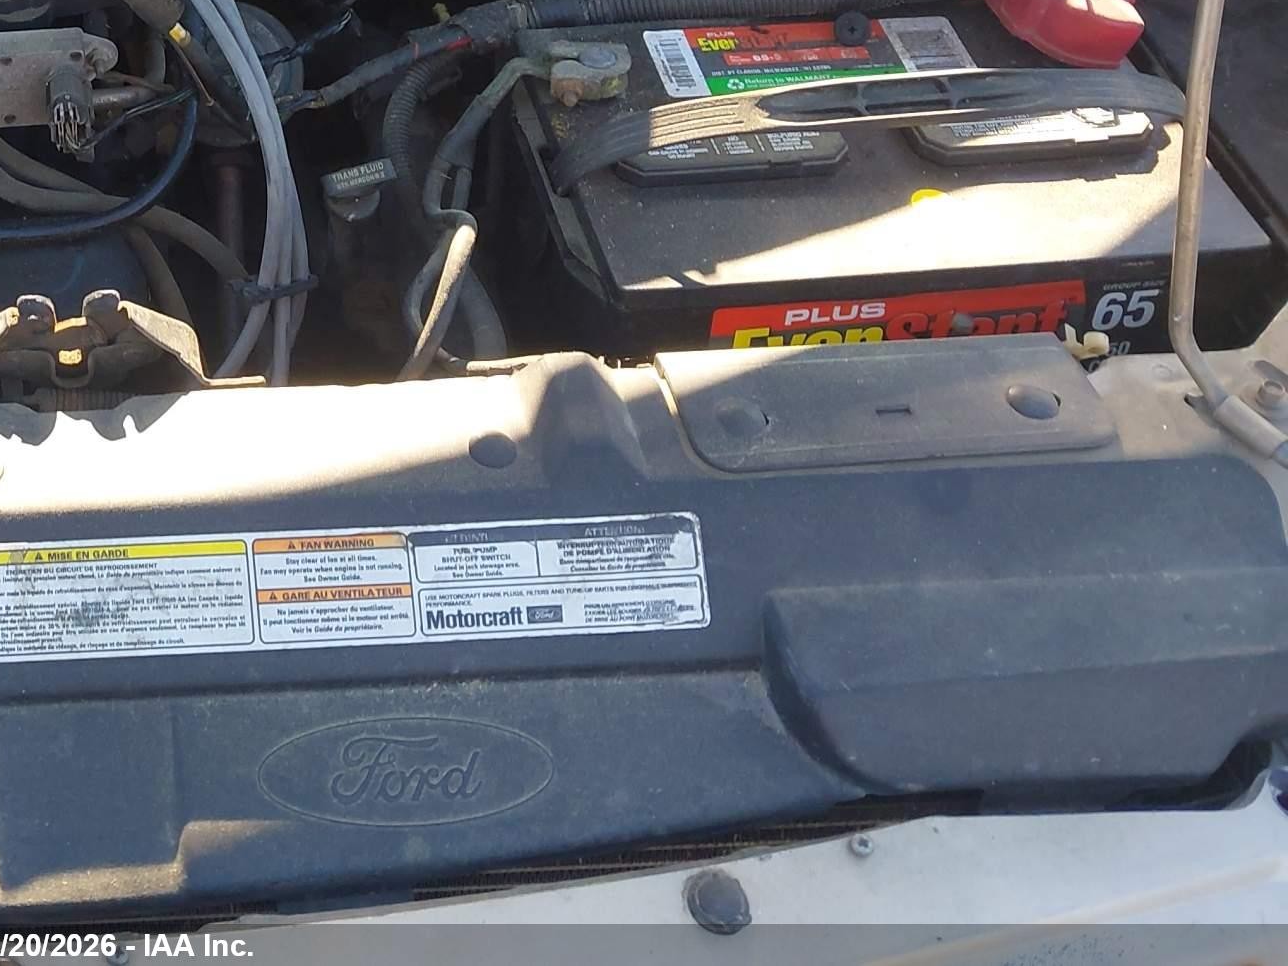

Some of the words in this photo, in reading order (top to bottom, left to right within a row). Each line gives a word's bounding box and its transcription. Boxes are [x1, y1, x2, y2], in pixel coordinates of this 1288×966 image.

[785, 302, 887, 326] PLUS
[1092, 289, 1160, 330] 65
[47, 551, 72, 561] MISE
[75, 550, 90, 560] EN
[93, 549, 129, 559] GARDE
[301, 540, 322, 550] FAN
[324, 539, 375, 548] WARNING
[283, 592, 311, 601] GARE
[314, 590, 327, 599] AU
[332, 587, 402, 598] VENTILATEUR
[426, 606, 524, 630] Motorcraft
[331, 735, 482, 804] Ford
